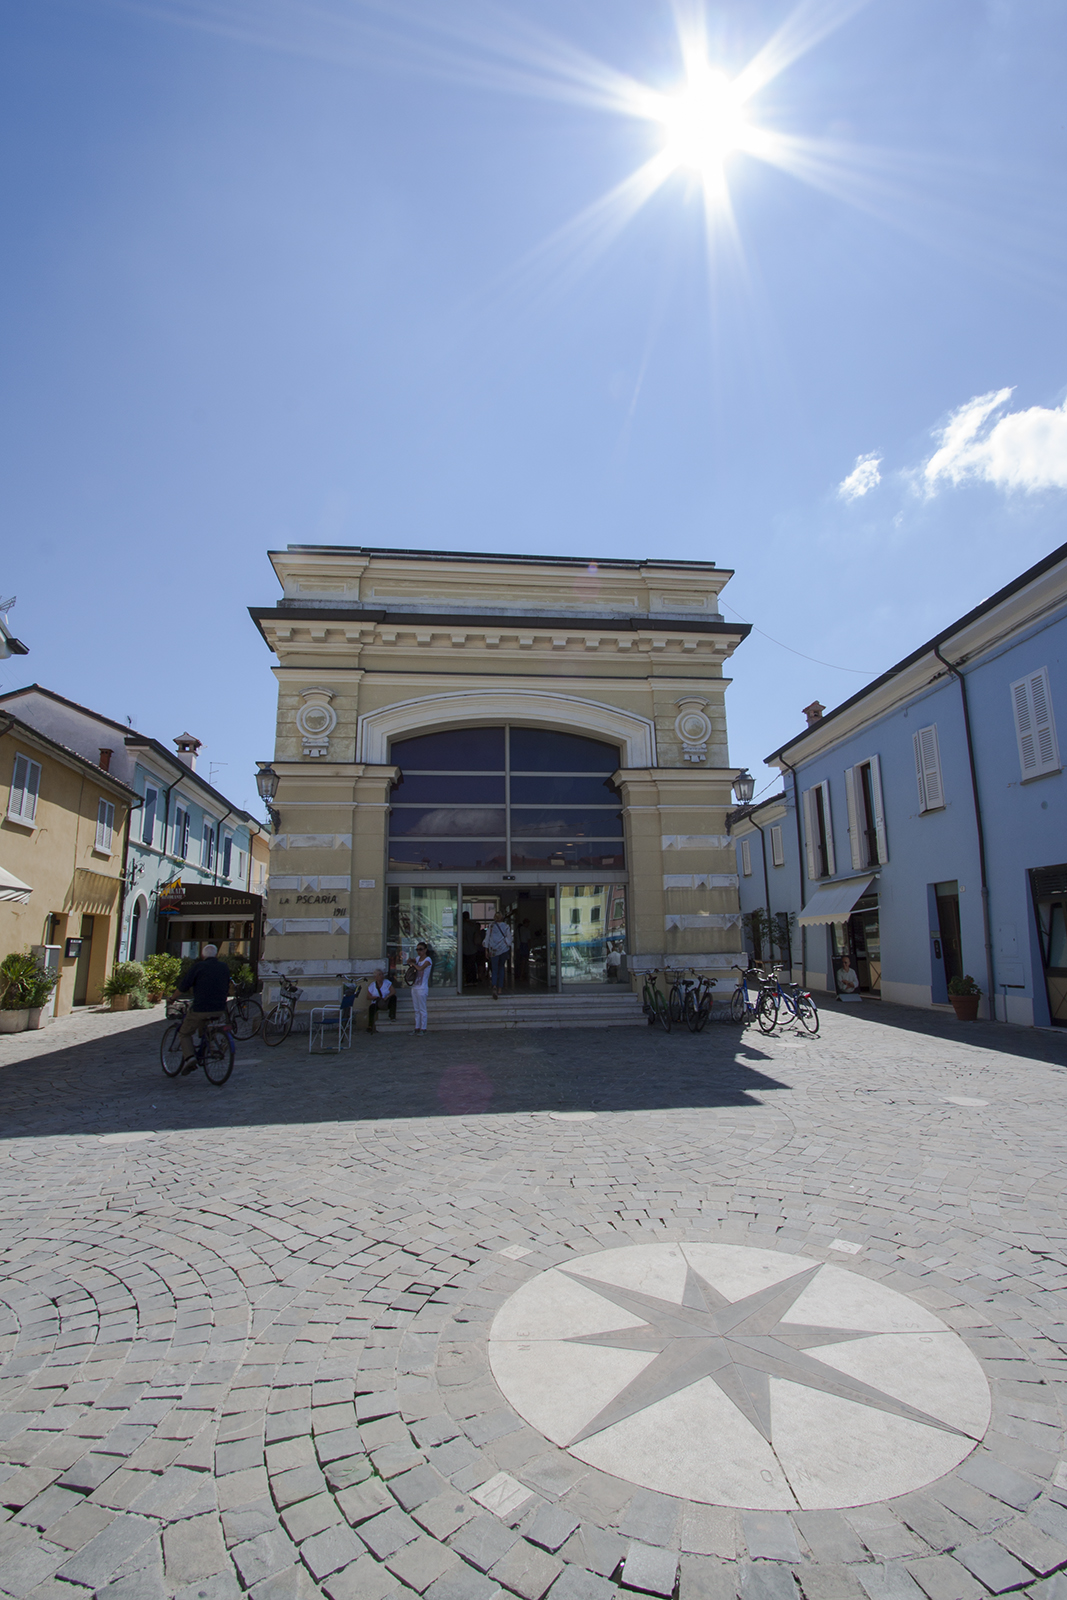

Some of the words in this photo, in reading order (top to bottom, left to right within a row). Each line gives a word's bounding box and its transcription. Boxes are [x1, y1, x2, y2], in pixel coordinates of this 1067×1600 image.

[222, 896, 251, 905] Pirata
[279, 897, 290, 905] LA
[333, 907, 347, 916] 1911
[839, 1241, 854, 1252] S
[483, 1479, 520, 1508] N
